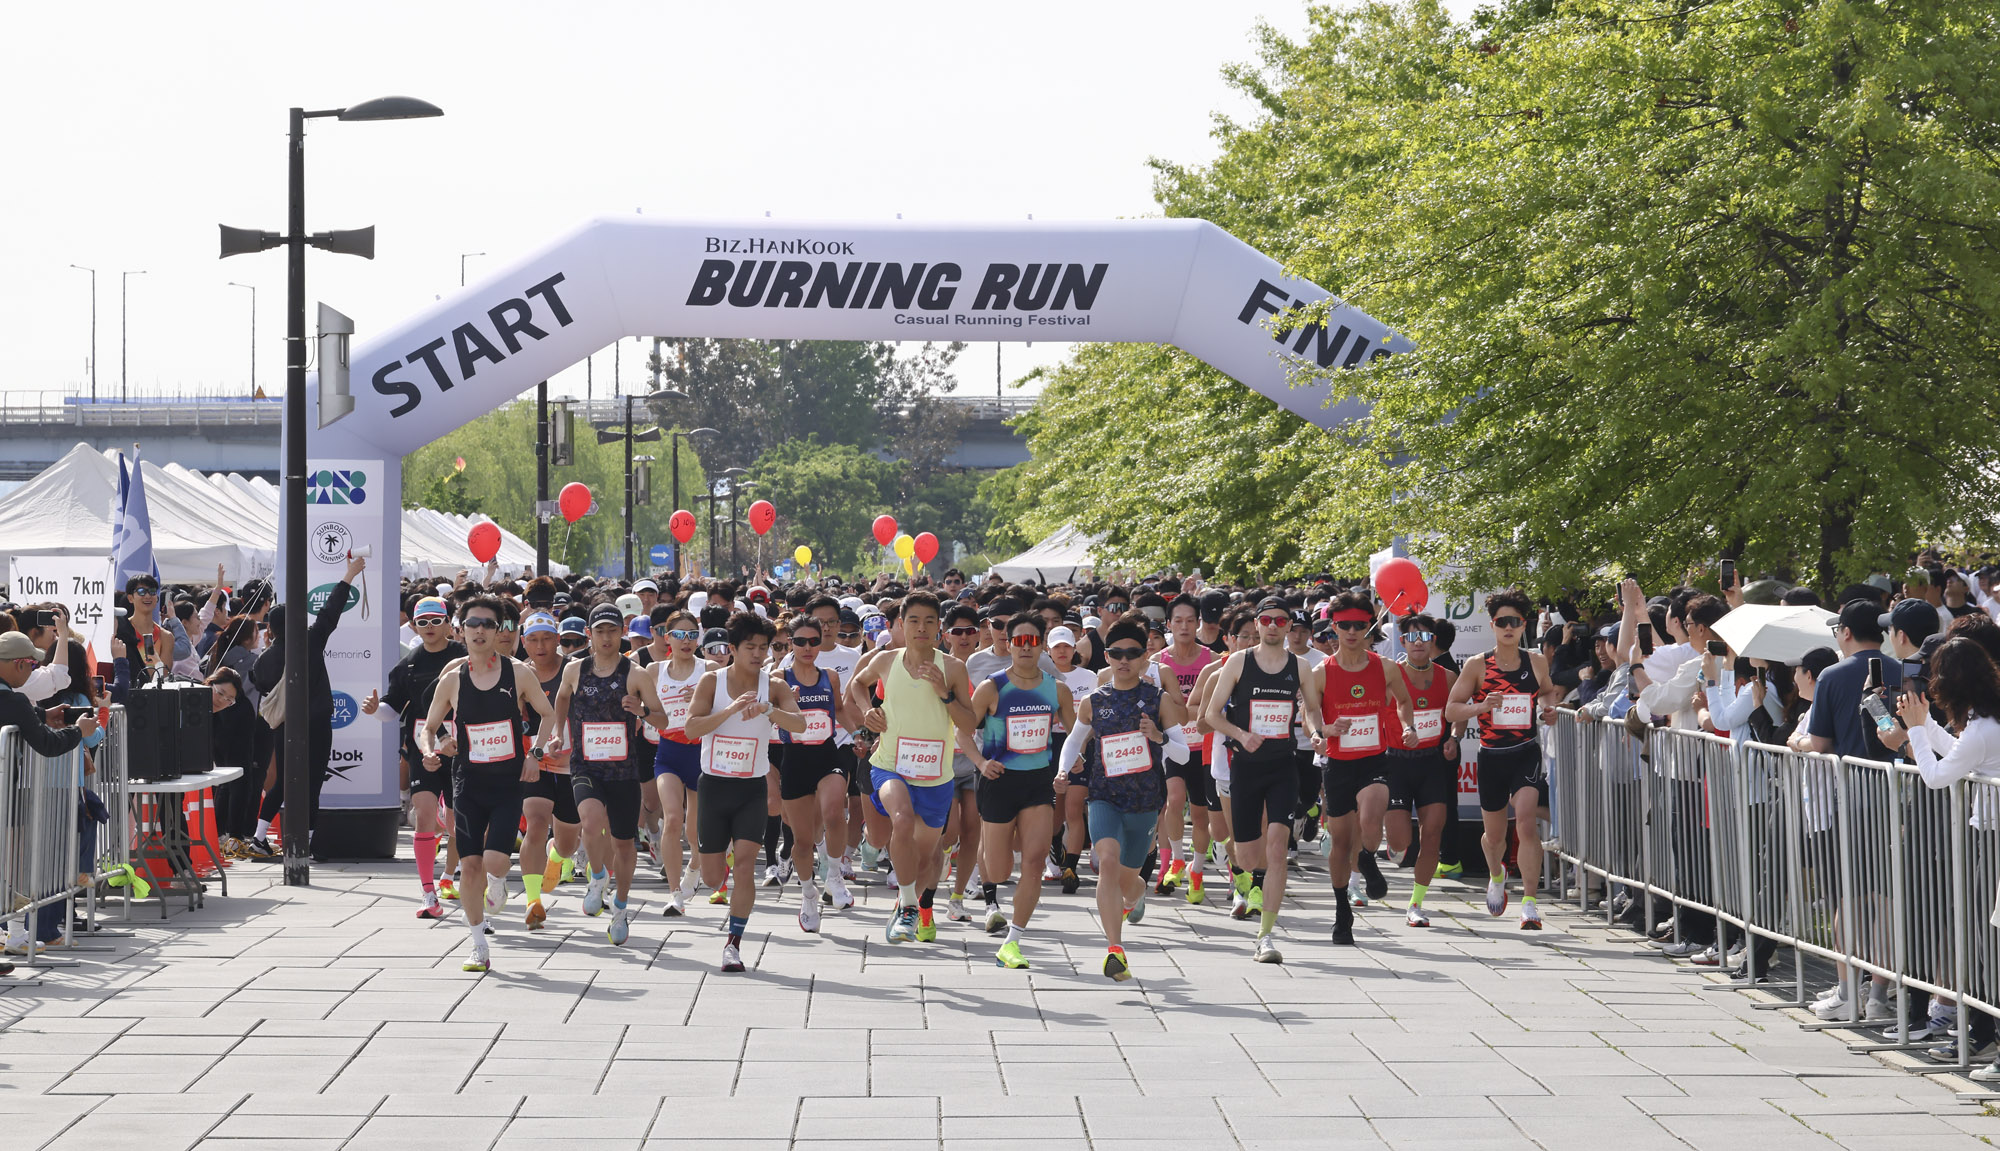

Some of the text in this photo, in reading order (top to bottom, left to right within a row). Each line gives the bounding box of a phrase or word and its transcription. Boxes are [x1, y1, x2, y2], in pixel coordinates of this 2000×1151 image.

[685, 259, 1109, 311] BURNING RUN
[894, 314, 1090, 327] Casual Running Festival
[371, 271, 574, 418] START
[316, 524, 347, 536] SUNBODY
[318, 552, 345, 562] TANNING
[18, 576, 105, 595] 10km 7km
[74, 602, 103, 625] 선수
[1009, 704, 1051, 713] SALOMON
[1503, 706, 1527, 714] 2464
[1264, 714, 1289, 723] 1955
[1417, 720, 1438, 730] 2456
[1021, 728, 1046, 738] 1910
[1350, 727, 1375, 736] 2457
[480, 735, 508, 747] 1460
[594, 736, 622, 745] 2448
[725, 750, 750, 760] 1901
[1115, 745, 1144, 759] 2449
[911, 753, 938, 763] 1809
